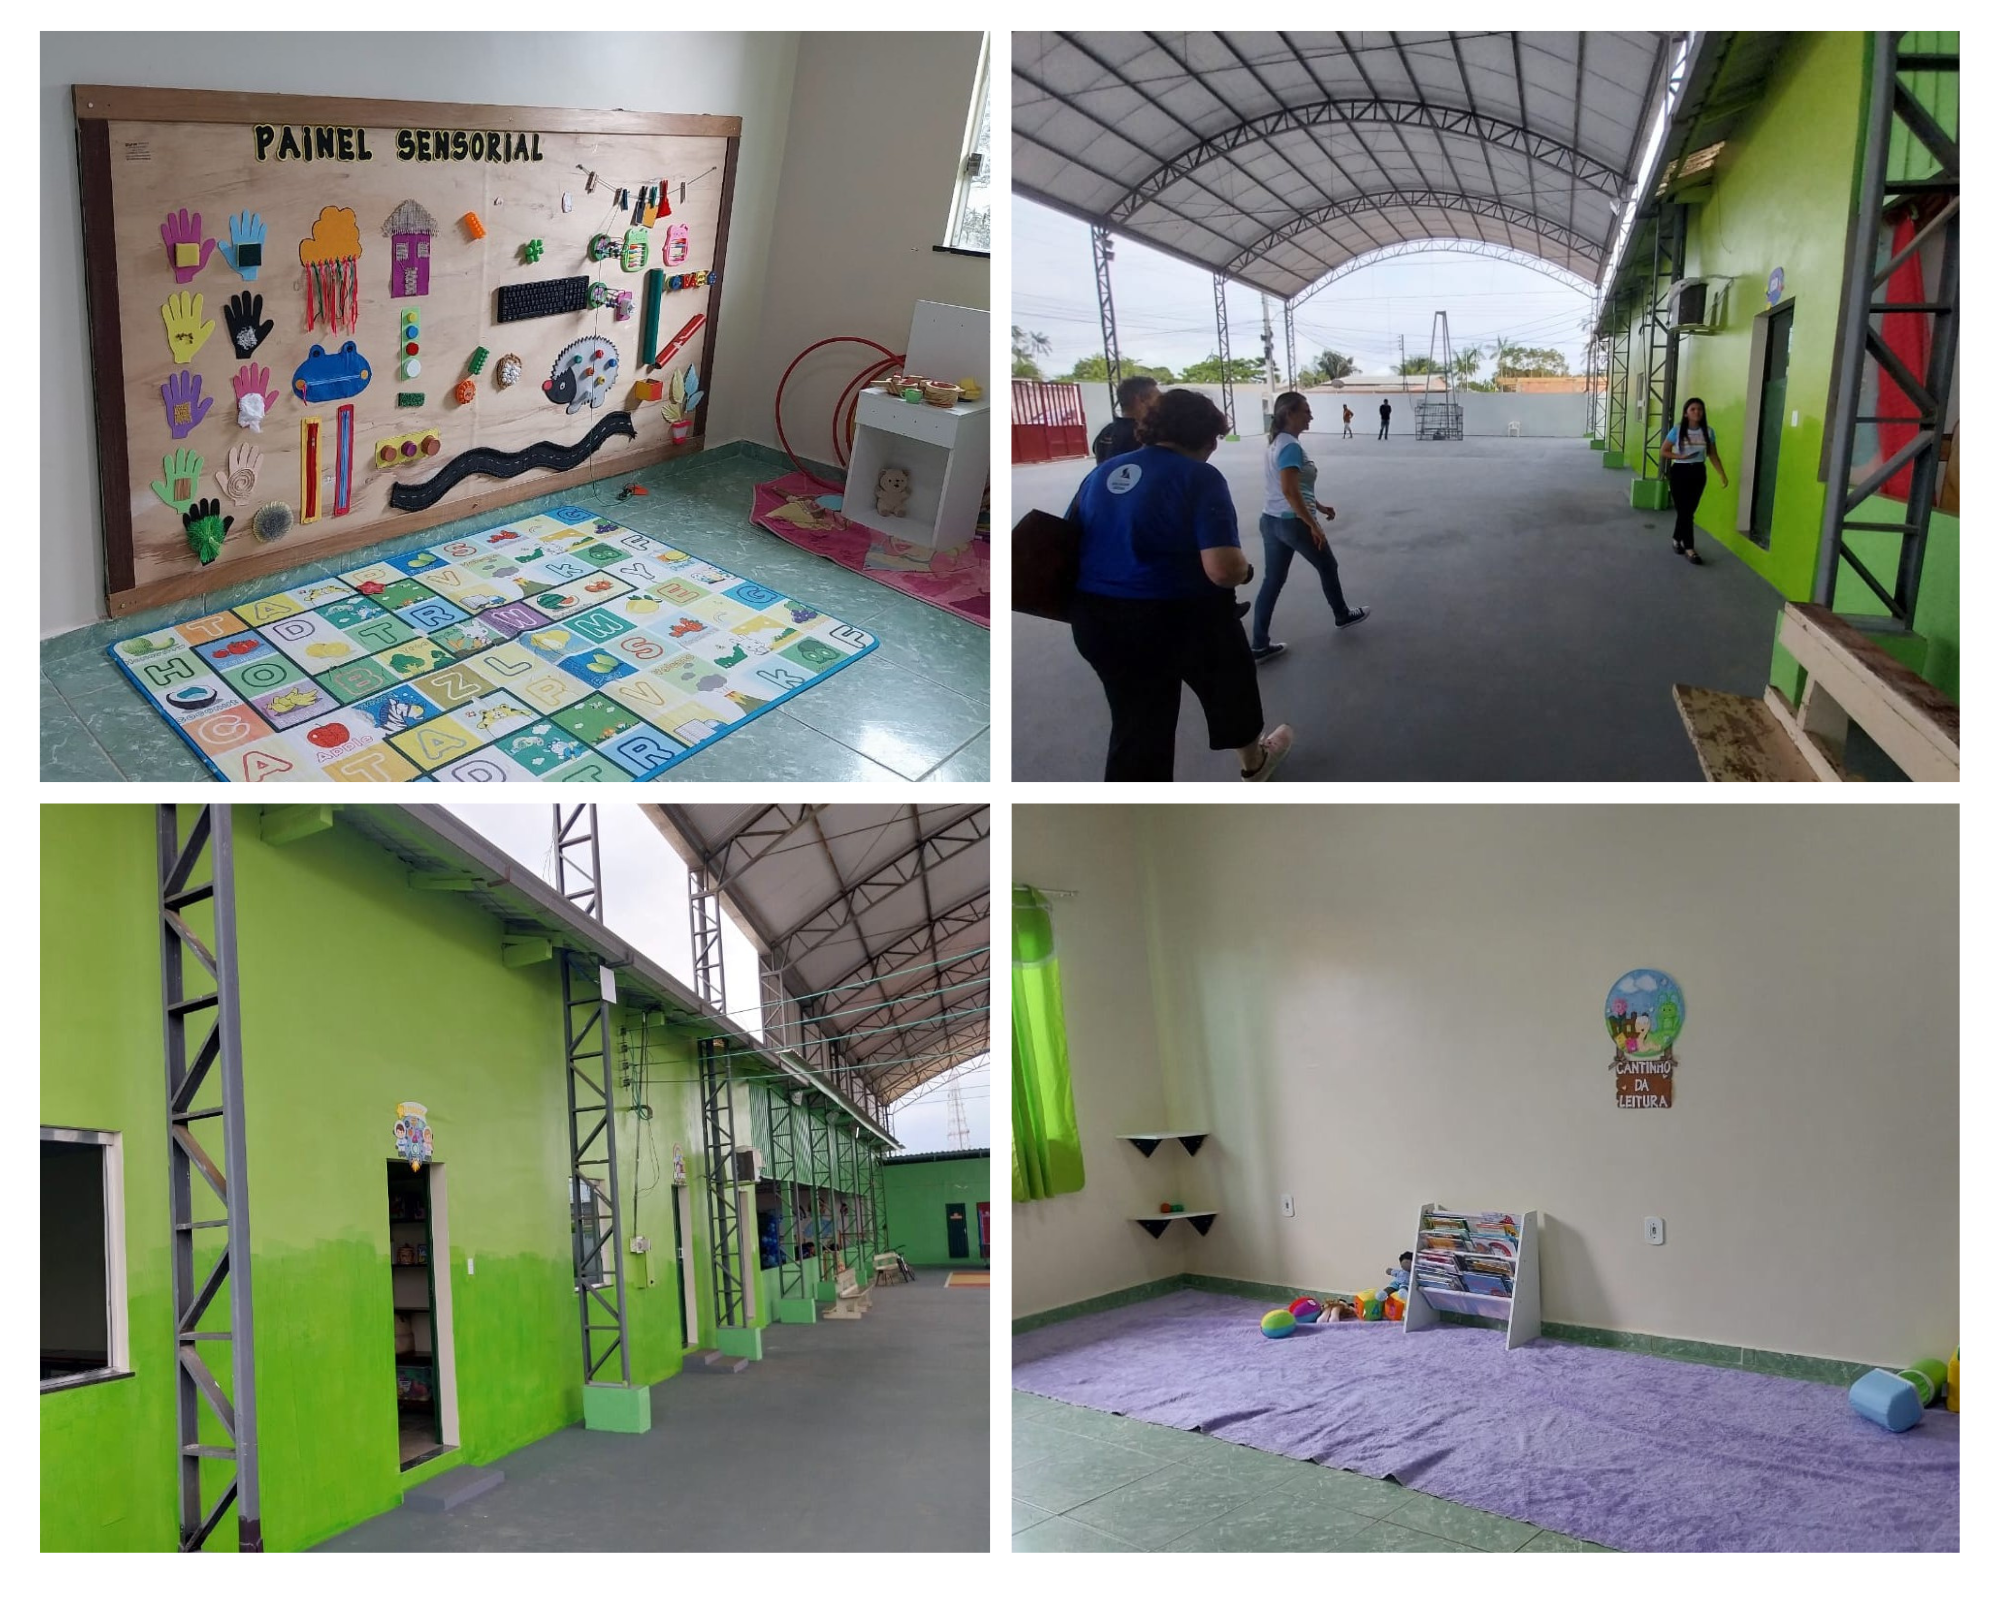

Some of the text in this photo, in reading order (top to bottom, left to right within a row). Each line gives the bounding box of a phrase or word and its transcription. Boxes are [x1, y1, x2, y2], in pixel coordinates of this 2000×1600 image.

[254, 124, 544, 164] PAINEL SENSORIAL
[444, 543, 477, 557] S
[621, 534, 650, 551] F
[427, 570, 461, 587] V
[620, 562, 655, 580] Y
[657, 582, 699, 604] E
[736, 585, 780, 604] G
[255, 602, 292, 621] A
[410, 605, 455, 627] R
[491, 608, 537, 629] W
[186, 615, 224, 637] T
[273, 620, 316, 641] D
[358, 622, 397, 644] T
[575, 613, 624, 638] M
[829, 624, 867, 649] F
[621, 637, 663, 659] S
[144, 657, 195, 686] H
[241, 663, 287, 688] O
[484, 656, 532, 677] L
[335, 667, 383, 696] B
[431, 672, 482, 700] Z
[526, 675, 567, 707] P
[619, 681, 665, 706] V
[199, 715, 250, 744] C
[317, 735, 374, 763] Apple
[418, 728, 467, 760] A
[617, 736, 675, 770] R
[243, 751, 294, 781] A
[341, 752, 392, 781] T
[1616, 1060, 1671, 1075] CANTINHO
[1634, 1078, 1650, 1092] DA
[1619, 1094, 1668, 1108] LEITURA
